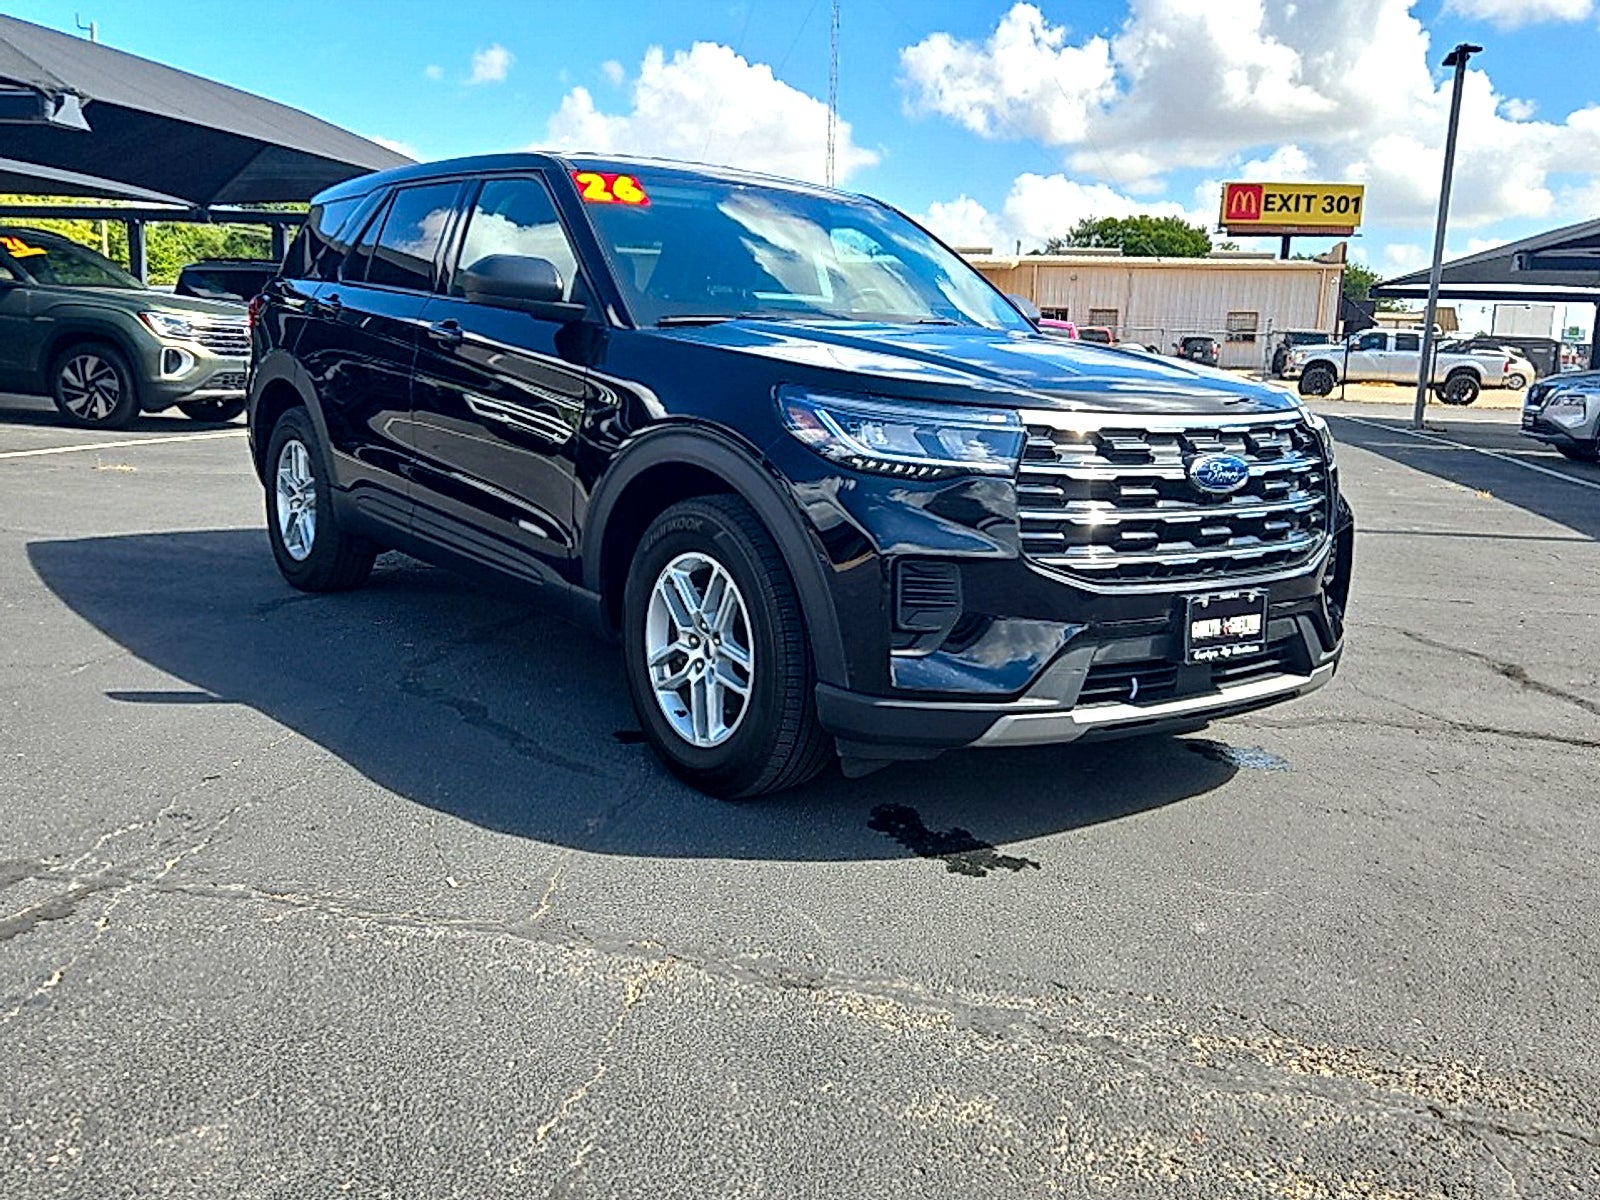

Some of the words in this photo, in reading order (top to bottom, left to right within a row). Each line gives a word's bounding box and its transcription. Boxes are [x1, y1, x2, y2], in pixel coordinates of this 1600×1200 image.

[576, 173, 645, 202] 26
[1263, 193, 1317, 213] EXIT
[1321, 195, 1362, 214] 301
